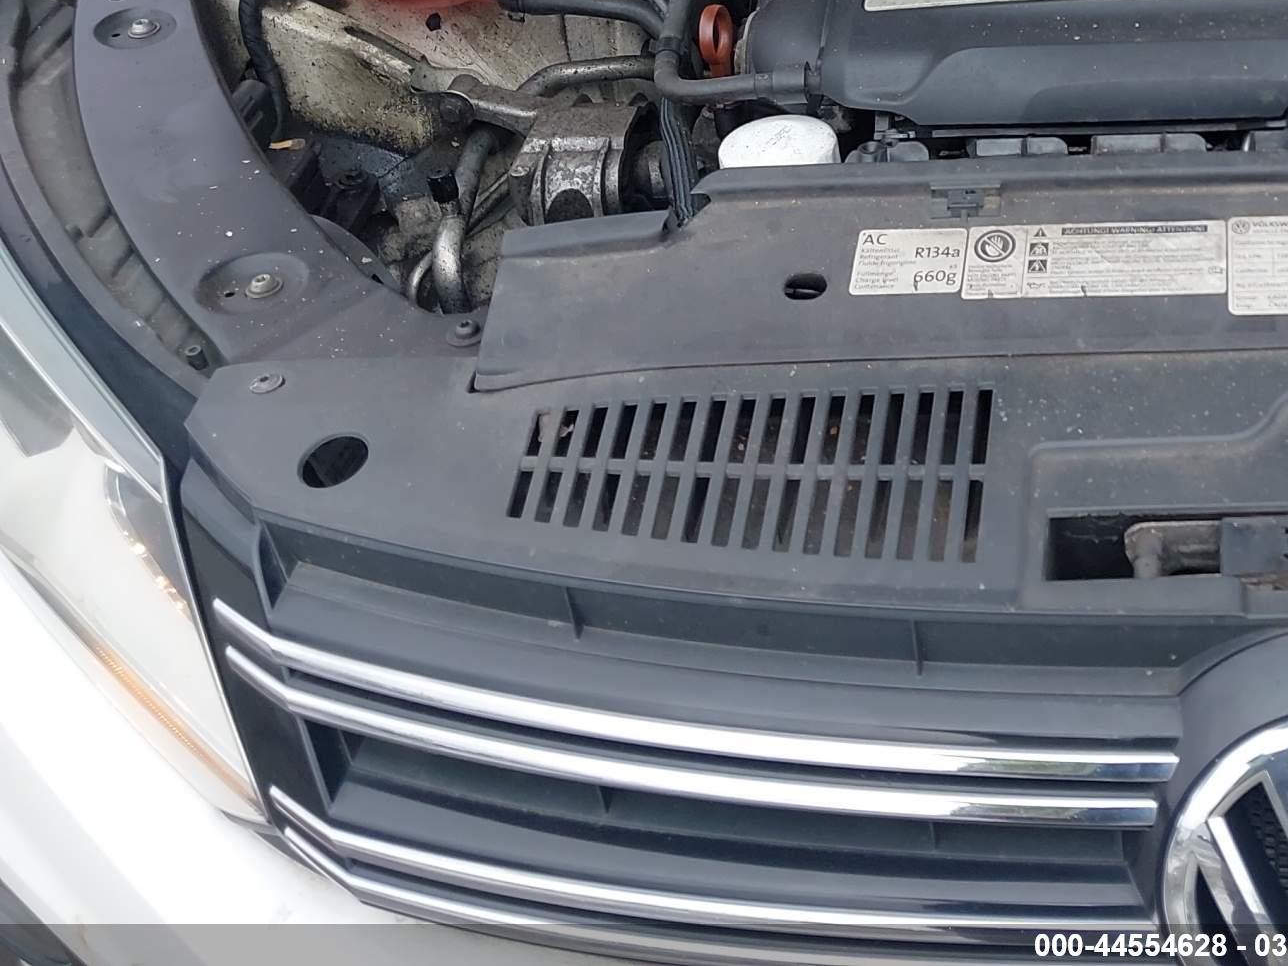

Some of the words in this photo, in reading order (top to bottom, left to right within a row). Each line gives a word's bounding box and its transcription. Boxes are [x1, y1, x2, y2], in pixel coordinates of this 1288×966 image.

[862, 233, 888, 245] AC
[914, 246, 961, 259] R134a
[913, 270, 958, 286] 660g
